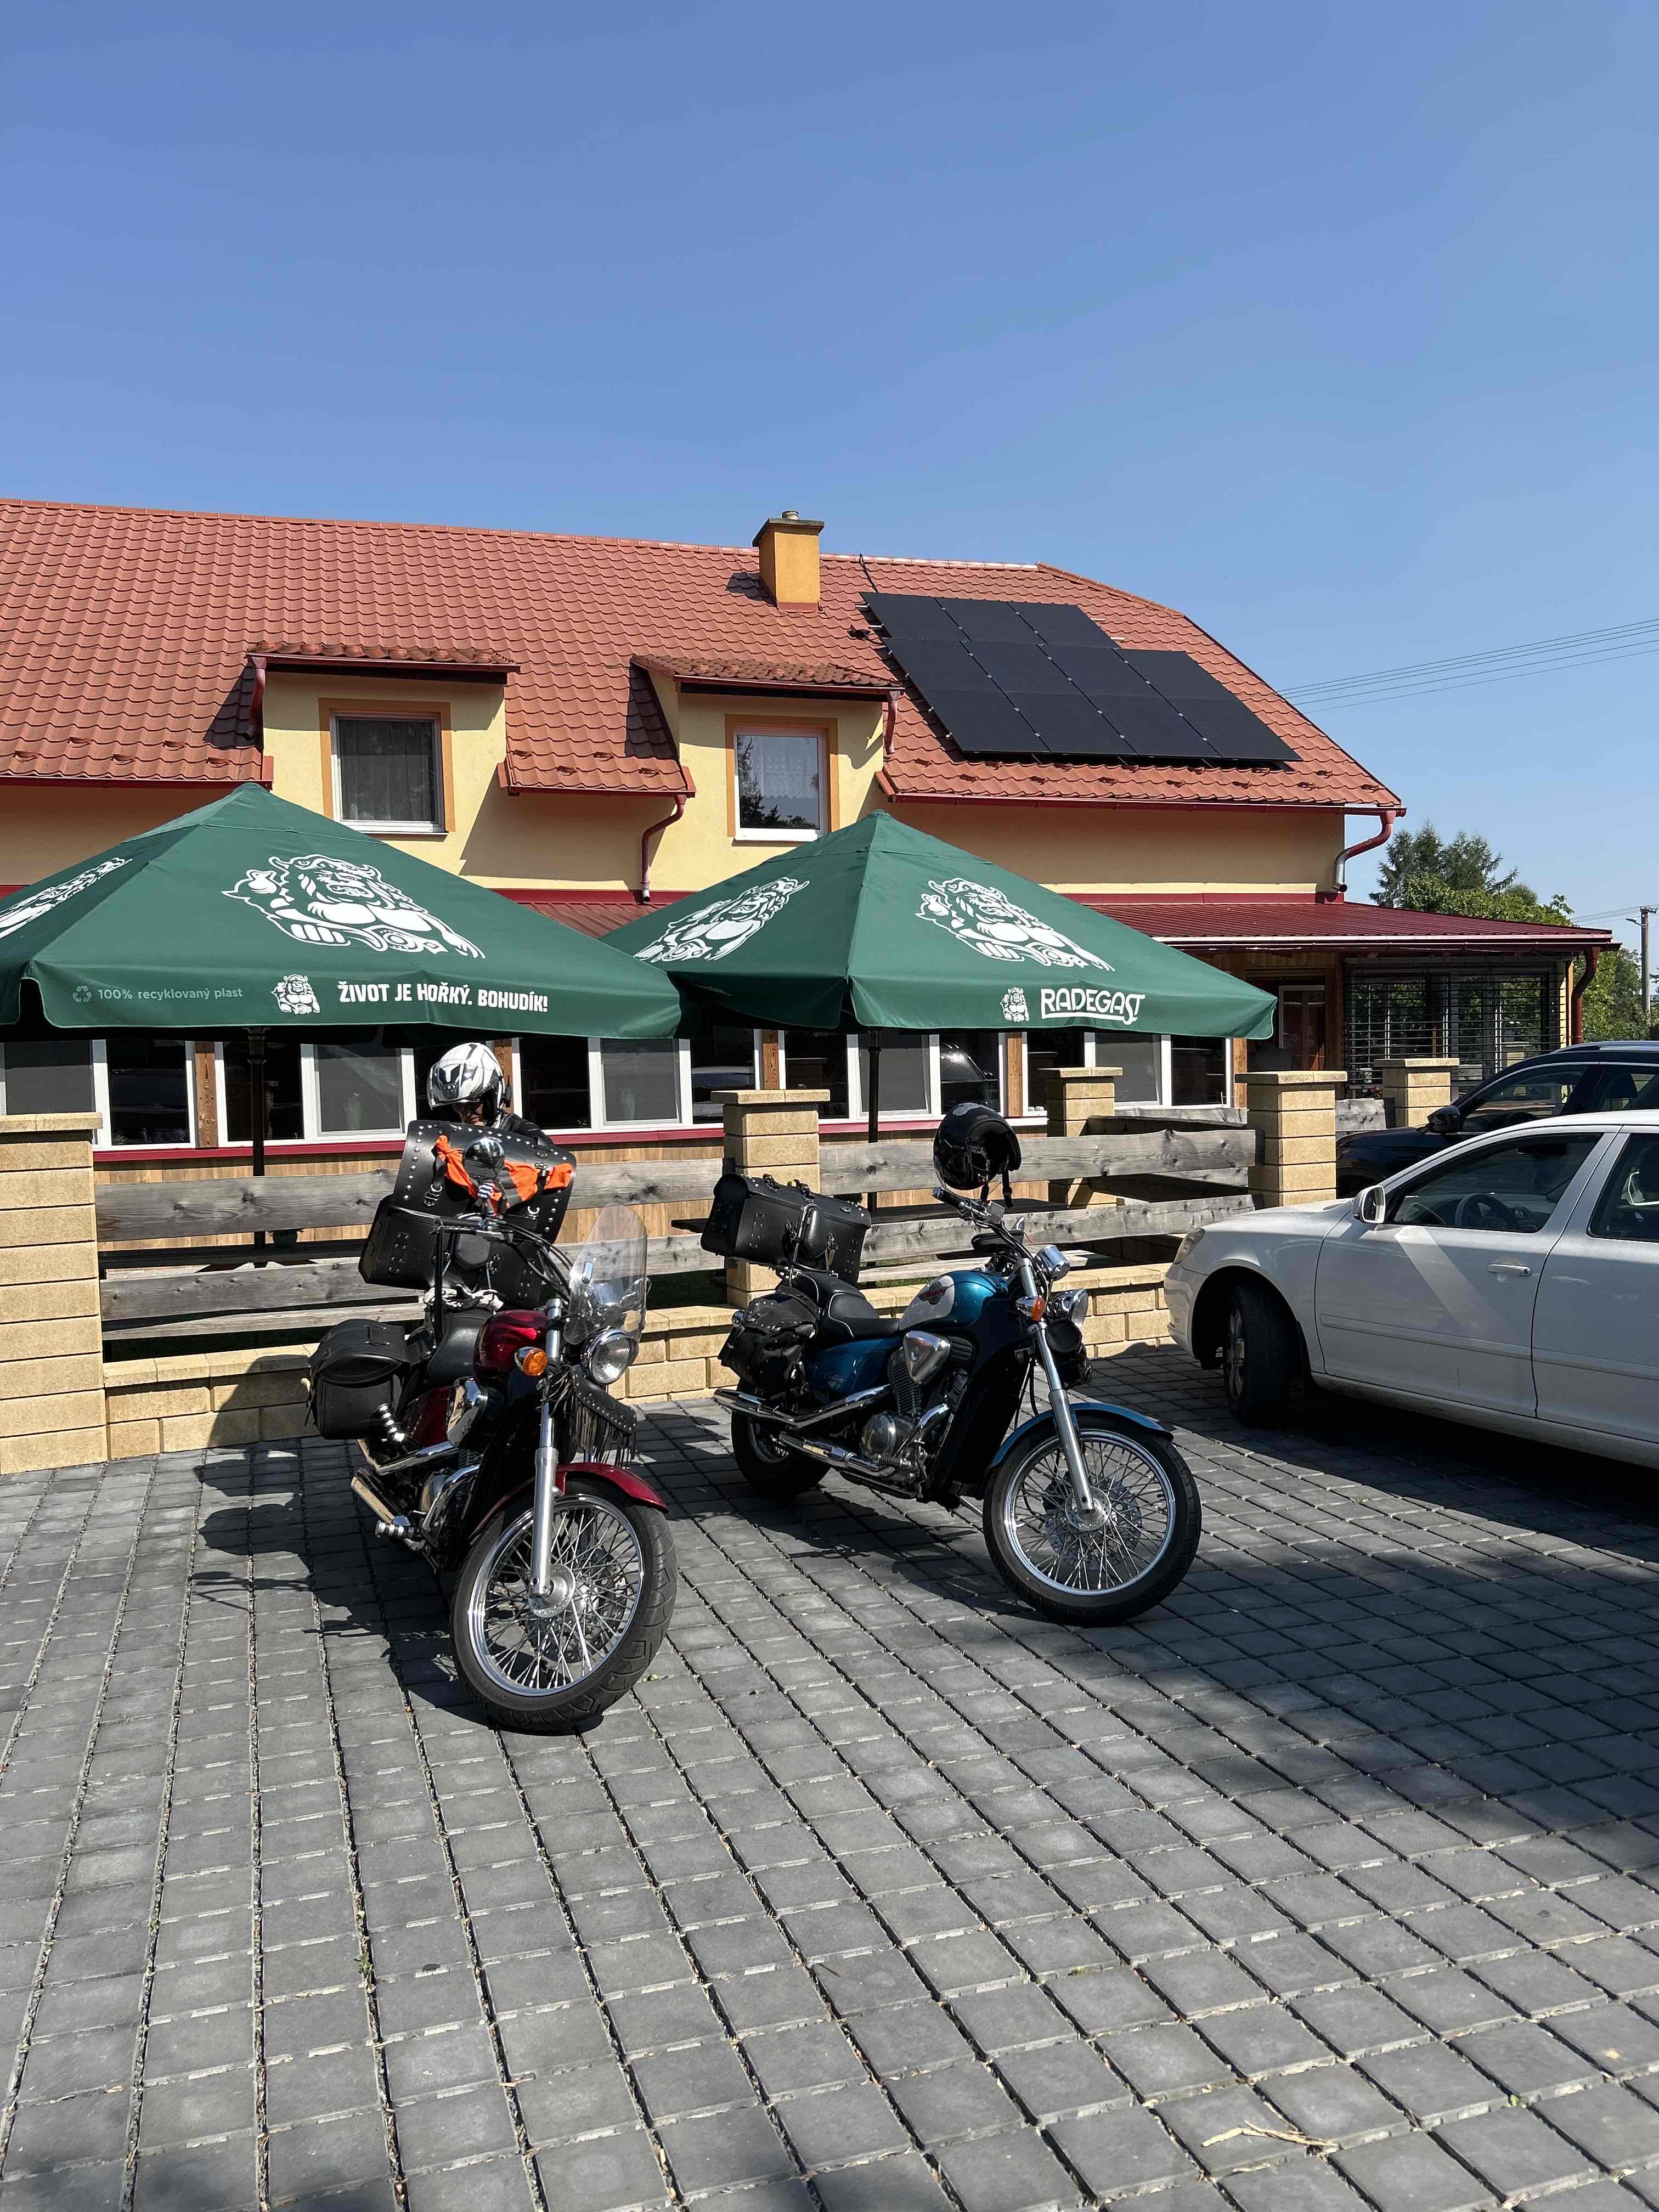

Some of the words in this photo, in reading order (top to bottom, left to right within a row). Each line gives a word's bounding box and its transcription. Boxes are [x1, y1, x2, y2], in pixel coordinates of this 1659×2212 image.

[98, 988, 133, 1000] 100%
[138, 987, 211, 1000] recyklovaný
[214, 987, 244, 1000] plast
[337, 980, 391, 1003] ŽIVOT
[394, 983, 413, 1002] JE
[417, 981, 473, 1006] HOŘKÝ.
[478, 989, 548, 1012] BOHUDÍK!
[1040, 988, 1146, 1025] RADEGAST
